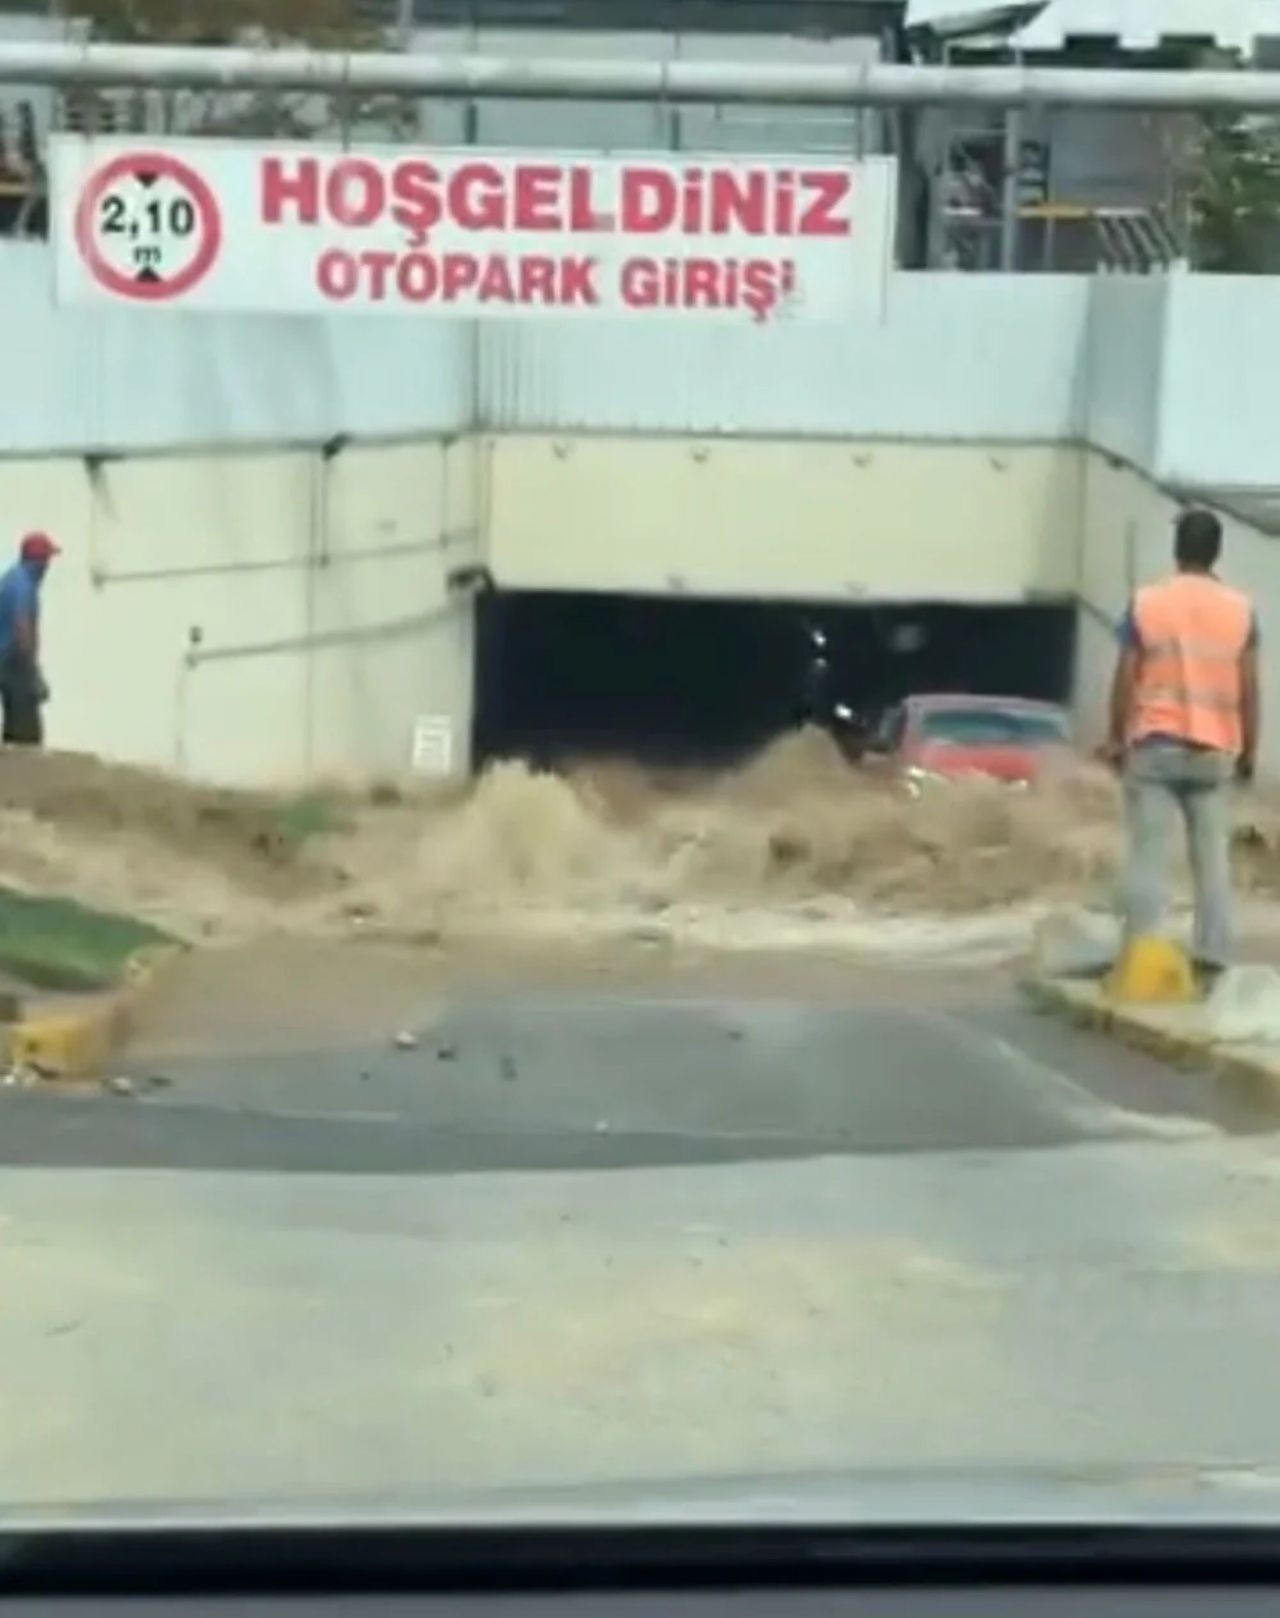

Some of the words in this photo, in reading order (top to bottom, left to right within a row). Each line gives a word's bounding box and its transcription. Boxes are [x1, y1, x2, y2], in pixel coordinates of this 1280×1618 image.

[101, 196, 195, 240] 2,10
[133, 245, 162, 265] m
[316, 247, 602, 306] OTOPARK
